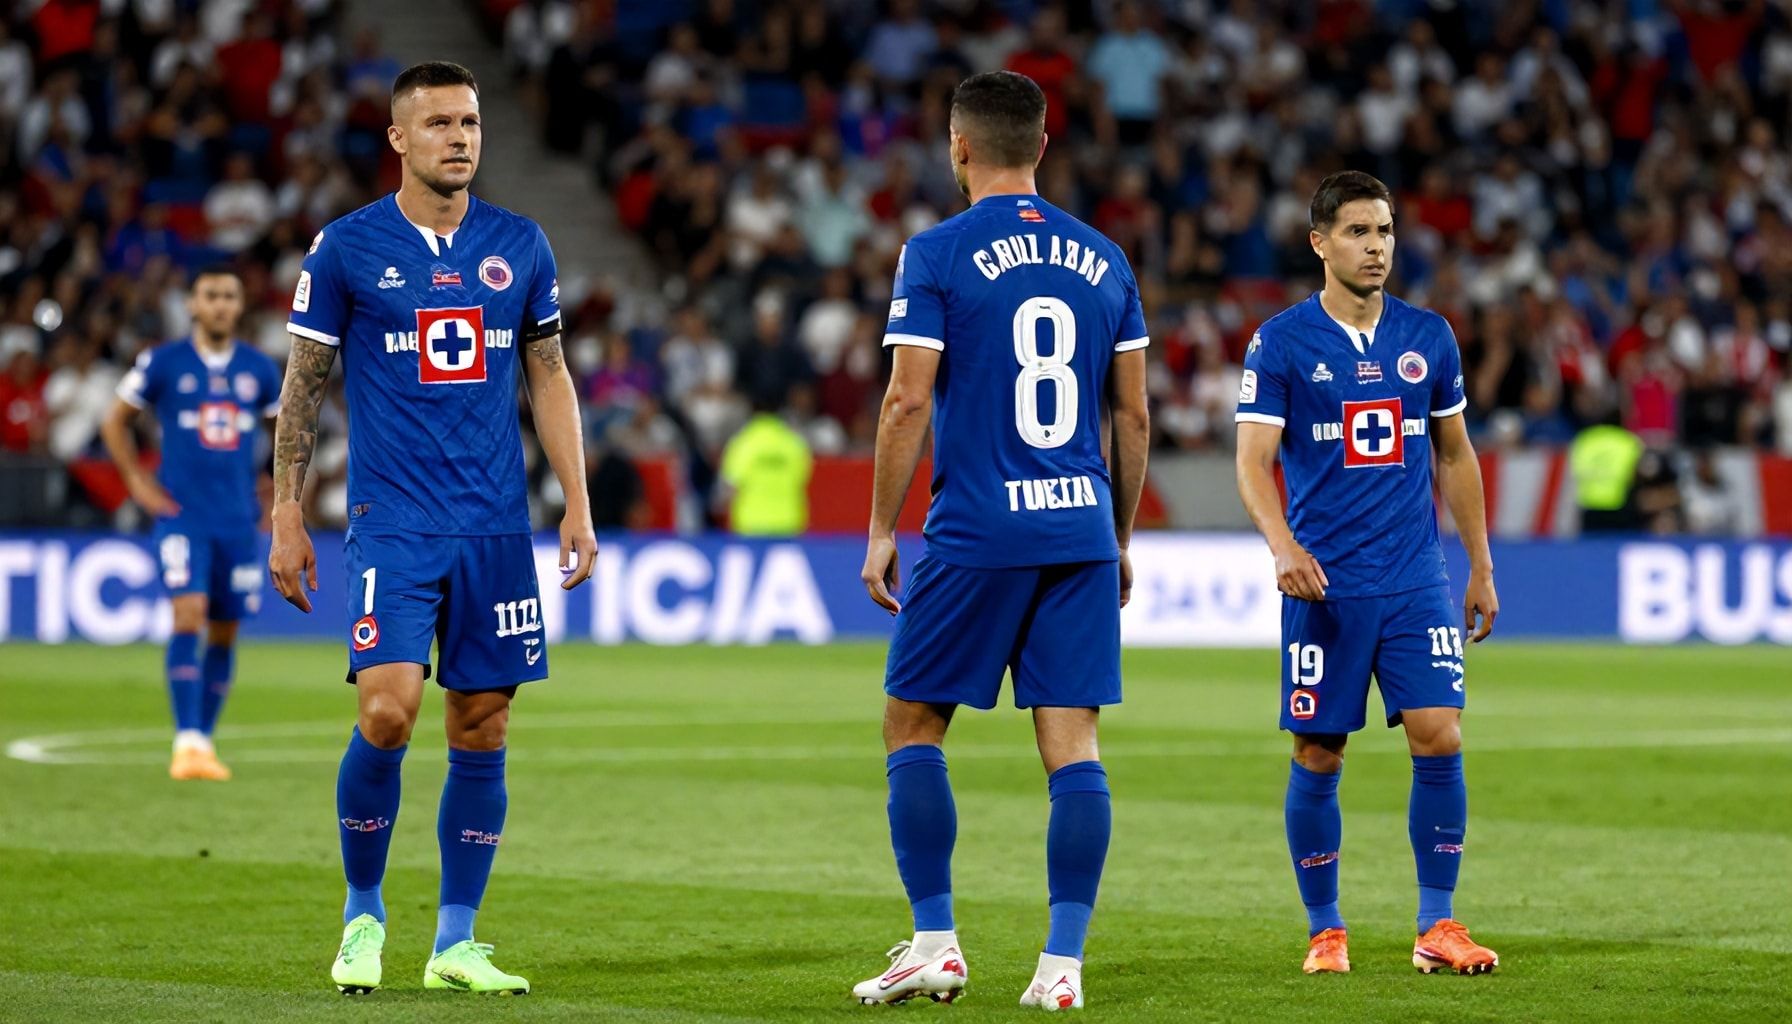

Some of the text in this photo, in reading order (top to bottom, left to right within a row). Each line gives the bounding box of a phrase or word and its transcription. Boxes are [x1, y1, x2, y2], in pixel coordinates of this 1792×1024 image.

[1013, 296, 1079, 449] 8
[362, 567, 376, 615] 1
[1618, 543, 1792, 646] BU
[1288, 641, 1324, 686] 19
